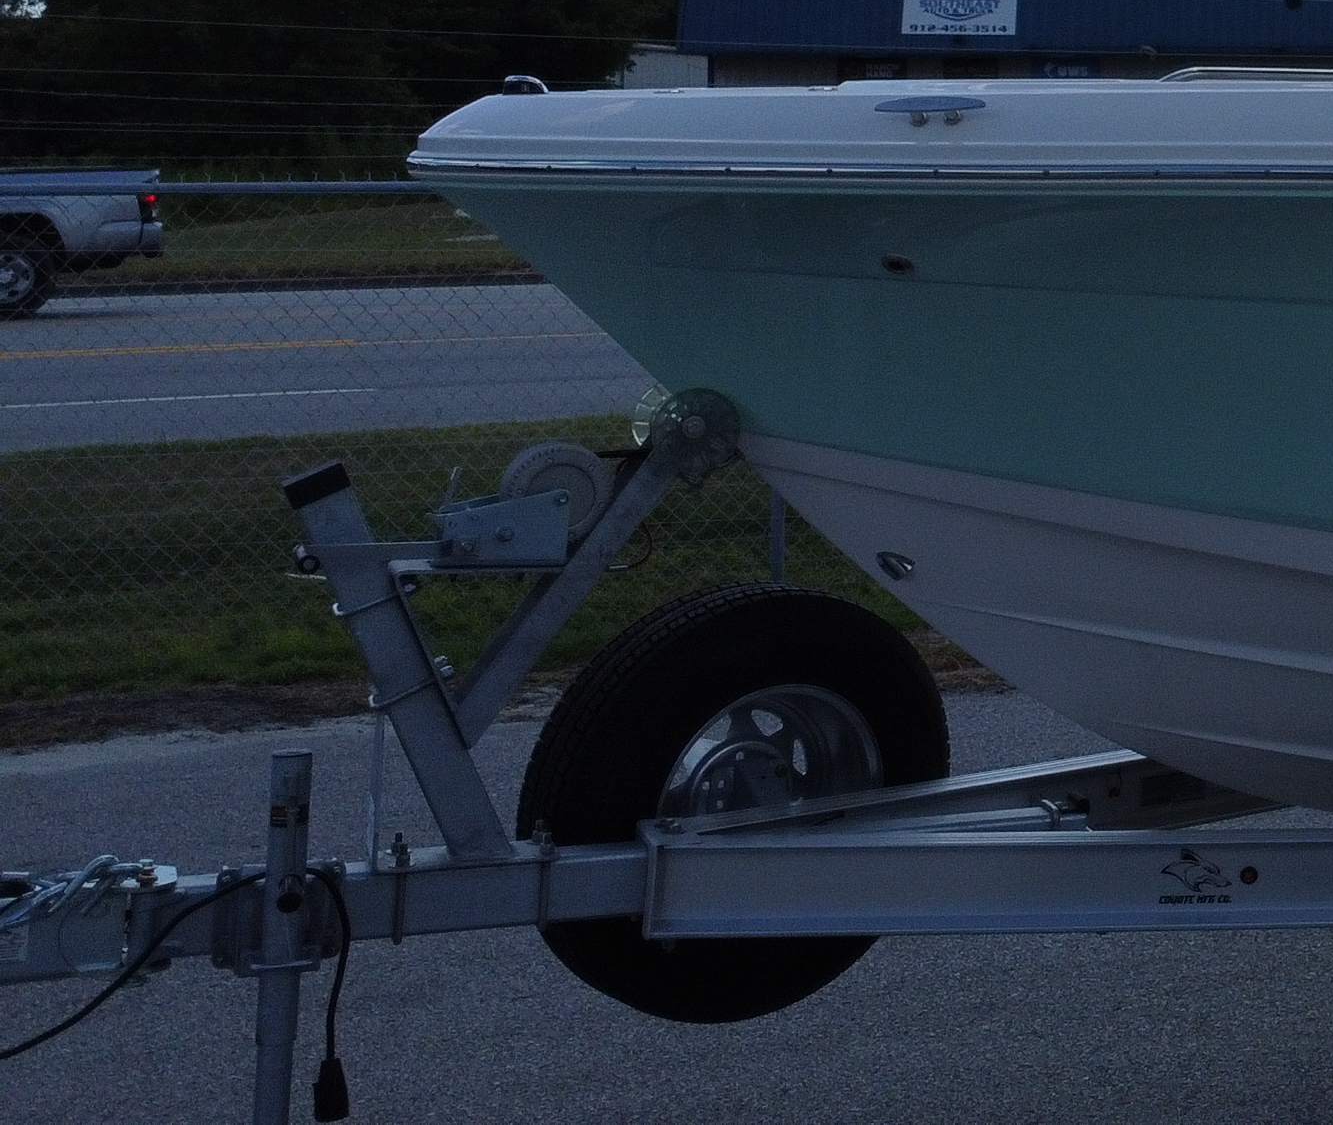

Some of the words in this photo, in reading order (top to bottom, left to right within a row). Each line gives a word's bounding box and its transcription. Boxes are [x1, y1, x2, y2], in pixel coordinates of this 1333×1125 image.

[919, 0, 1000, 9] SOUTHEAST
[909, 24, 1007, 33] 912-456-3514
[1159, 895, 1196, 904] COYOTE
